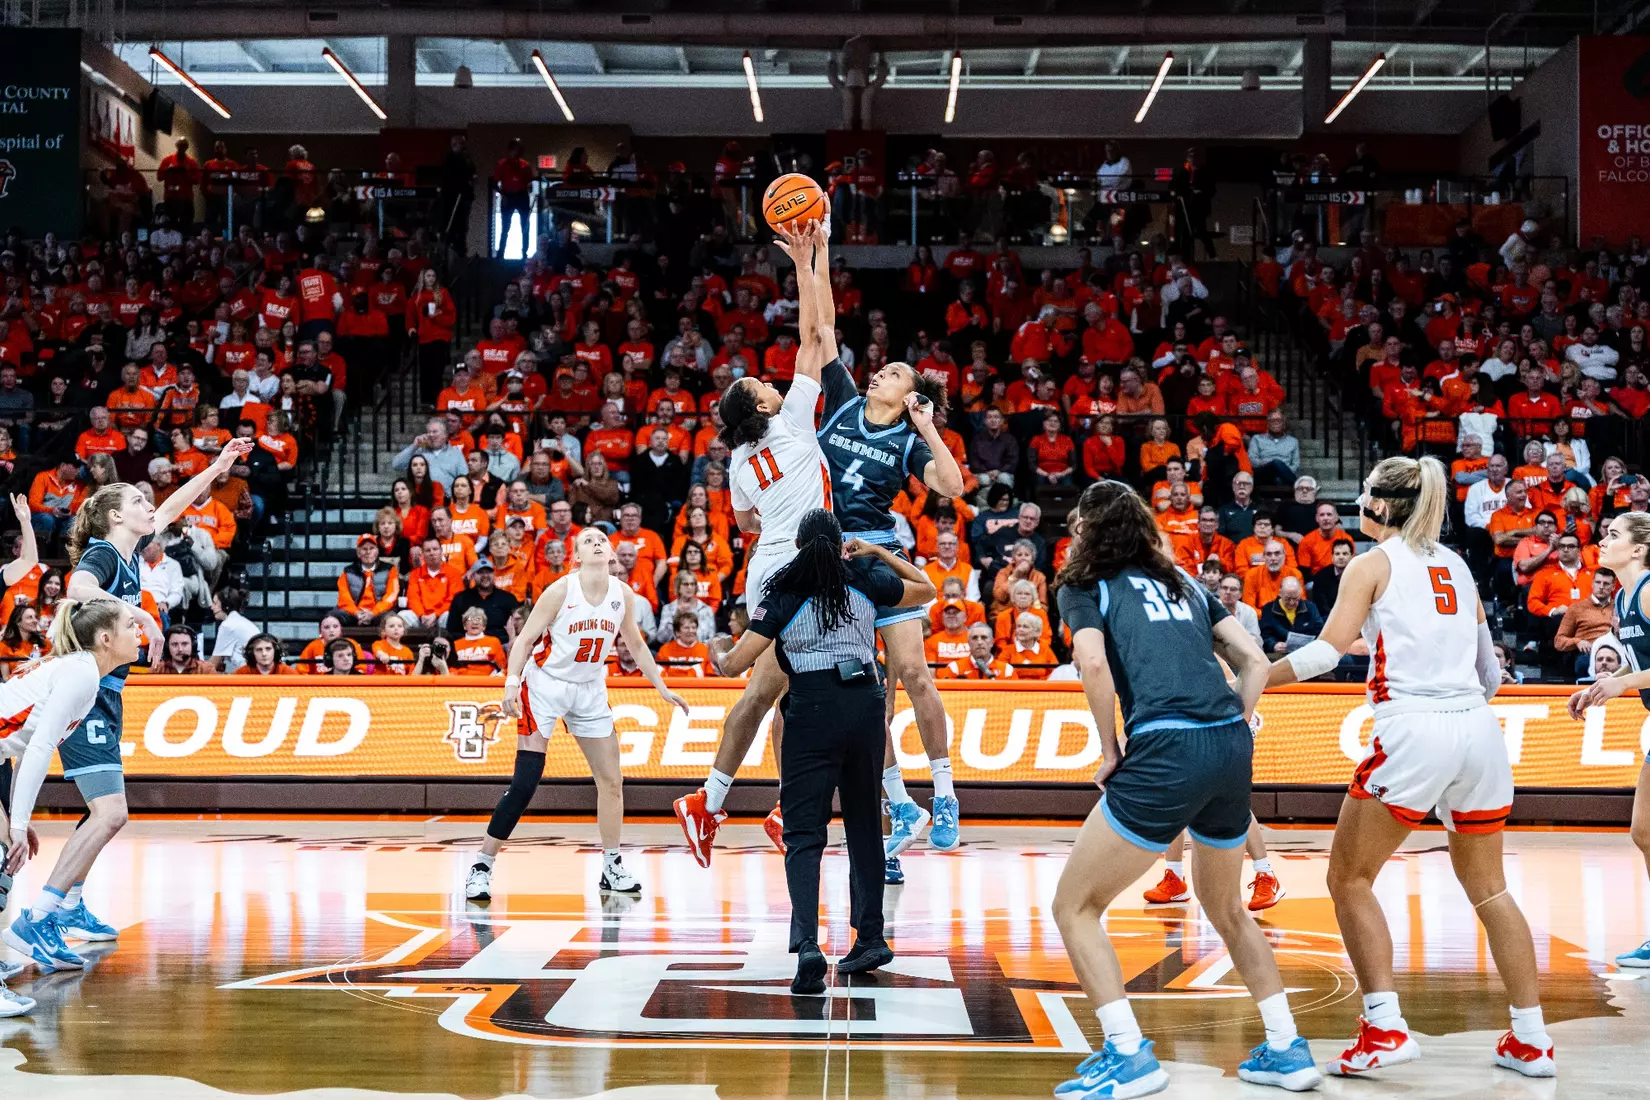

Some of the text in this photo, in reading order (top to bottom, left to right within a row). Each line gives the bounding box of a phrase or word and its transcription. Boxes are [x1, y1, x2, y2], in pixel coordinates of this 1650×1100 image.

[5, 84, 70, 100] COUNTY
[45, 133, 64, 149] of
[1607, 140, 1620, 153] &
[1614, 156, 1636, 168] OF
[1599, 170, 1650, 182] FALCO
[774, 194, 807, 216] ELITE
[1571, 406, 1592, 417] BEA
[828, 433, 896, 467] COLUMBIA
[748, 447, 784, 491] 11
[841, 458, 865, 492] 4
[1427, 566, 1458, 615] 5
[568, 618, 598, 635] BOWLING
[574, 637, 604, 663] 21
[86, 719, 107, 745] C
[120, 695, 371, 758] OUD
[889, 707, 1103, 770] OUD
[1580, 705, 1650, 765] L
